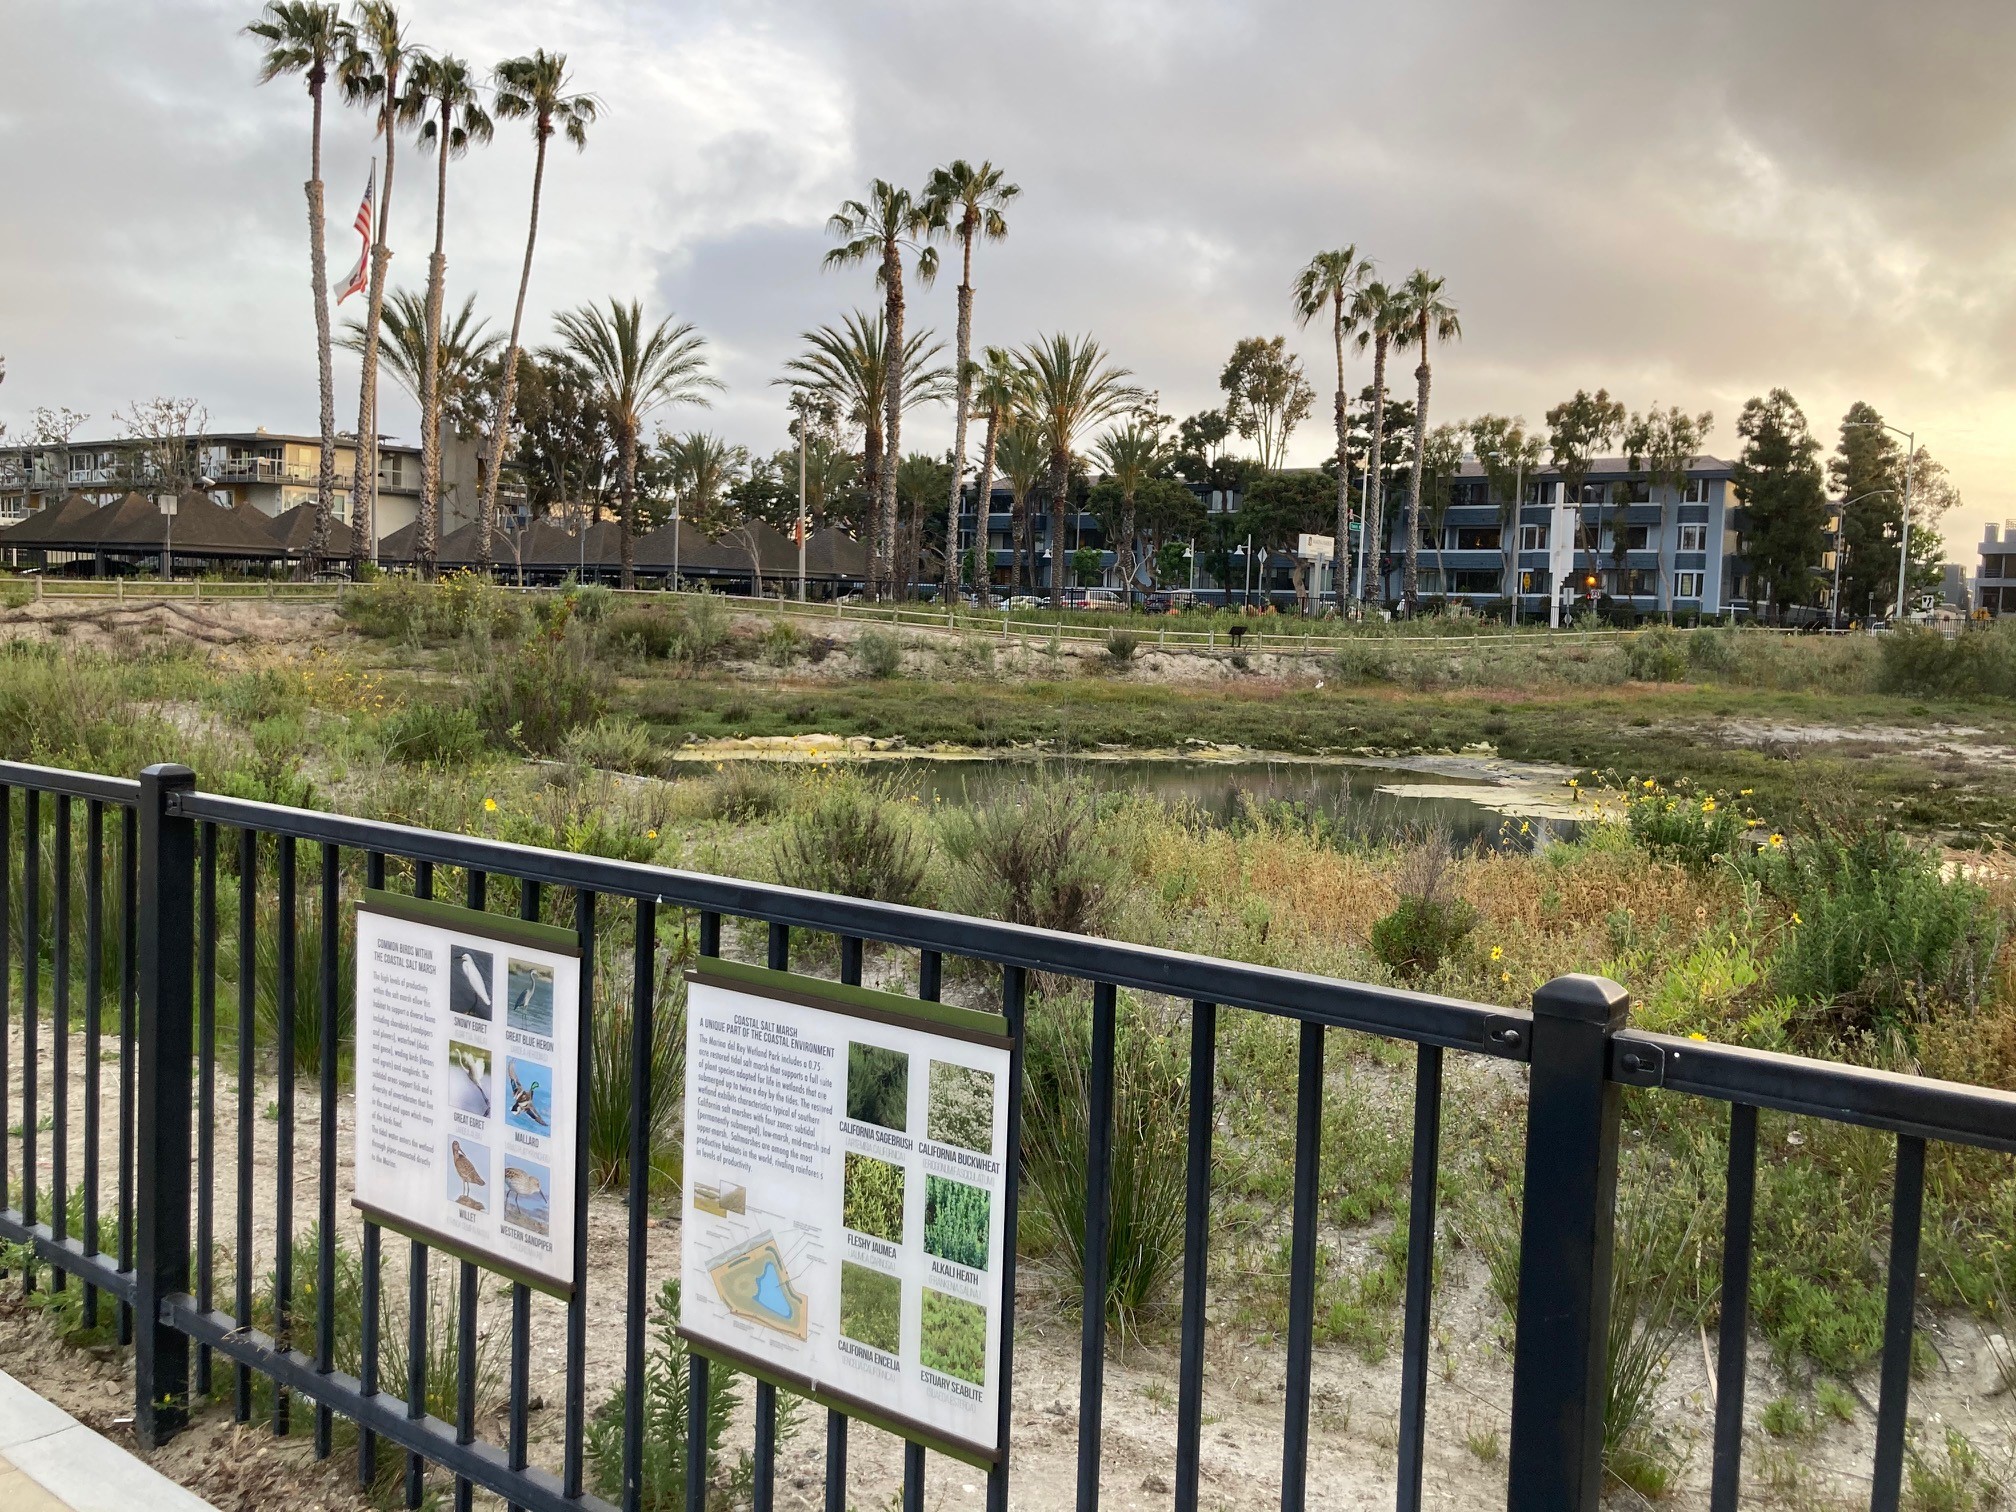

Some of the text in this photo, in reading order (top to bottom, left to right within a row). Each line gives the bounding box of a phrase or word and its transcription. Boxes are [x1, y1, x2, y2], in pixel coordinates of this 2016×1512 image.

[377, 939, 433, 960] COMMON BIRDS WITHIN
[374, 951, 436, 975] THE COASTAL SALT MARSH
[454, 1017, 488, 1034] SNOWY EGRET
[699, 1017, 834, 1057] A UNIQUE PART OF THE COASTAL ENVIRONMENT
[734, 1015, 798, 1038] COASTAL SALT MARSH
[506, 1030, 554, 1052] GREAT BLUE HERON
[818, 1092, 827, 1101] ae
[454, 1112, 484, 1130] GREAT EGRET
[811, 1104, 833, 1115] resored
[515, 1132, 539, 1148] MALLARD
[839, 1121, 914, 1151] CALIFORNIA SAGEBRUSH
[918, 1142, 1000, 1175] CALIFORNIA BUCKWHEAT
[796, 1165, 823, 1179] rainforess
[459, 1208, 476, 1222] WILLET
[501, 1224, 524, 1242] WESTERN
[524, 1233, 552, 1253] SANDPIPER
[847, 1233, 897, 1259] FLESHY JAUMEA
[931, 1261, 979, 1285] ALKALI HEATH
[838, 1339, 900, 1372] CALIFORNIA ENCELIA
[920, 1370, 983, 1402] ESTUARY SEABLITE
